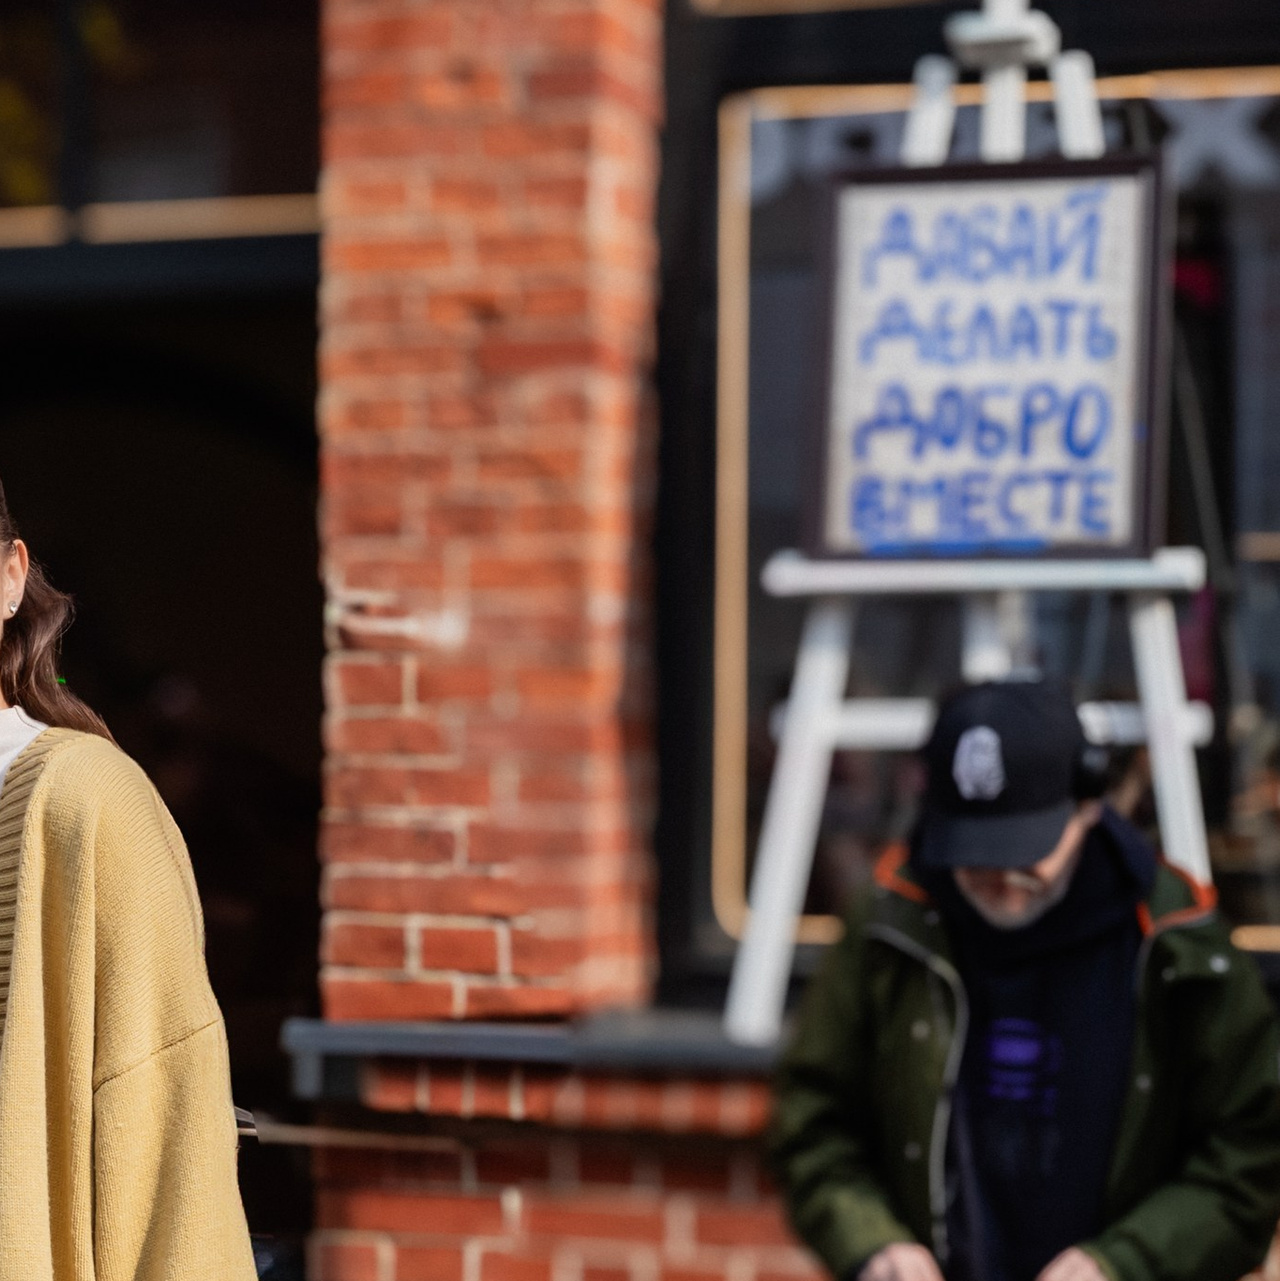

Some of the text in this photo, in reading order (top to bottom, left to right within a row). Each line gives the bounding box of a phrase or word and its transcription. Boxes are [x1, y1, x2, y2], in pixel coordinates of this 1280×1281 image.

[856, 295, 1118, 368] ДЕЛАТЬ
[851, 383, 1113, 464] ДОБРО
[849, 467, 1114, 540] ВМЕСТЕ
